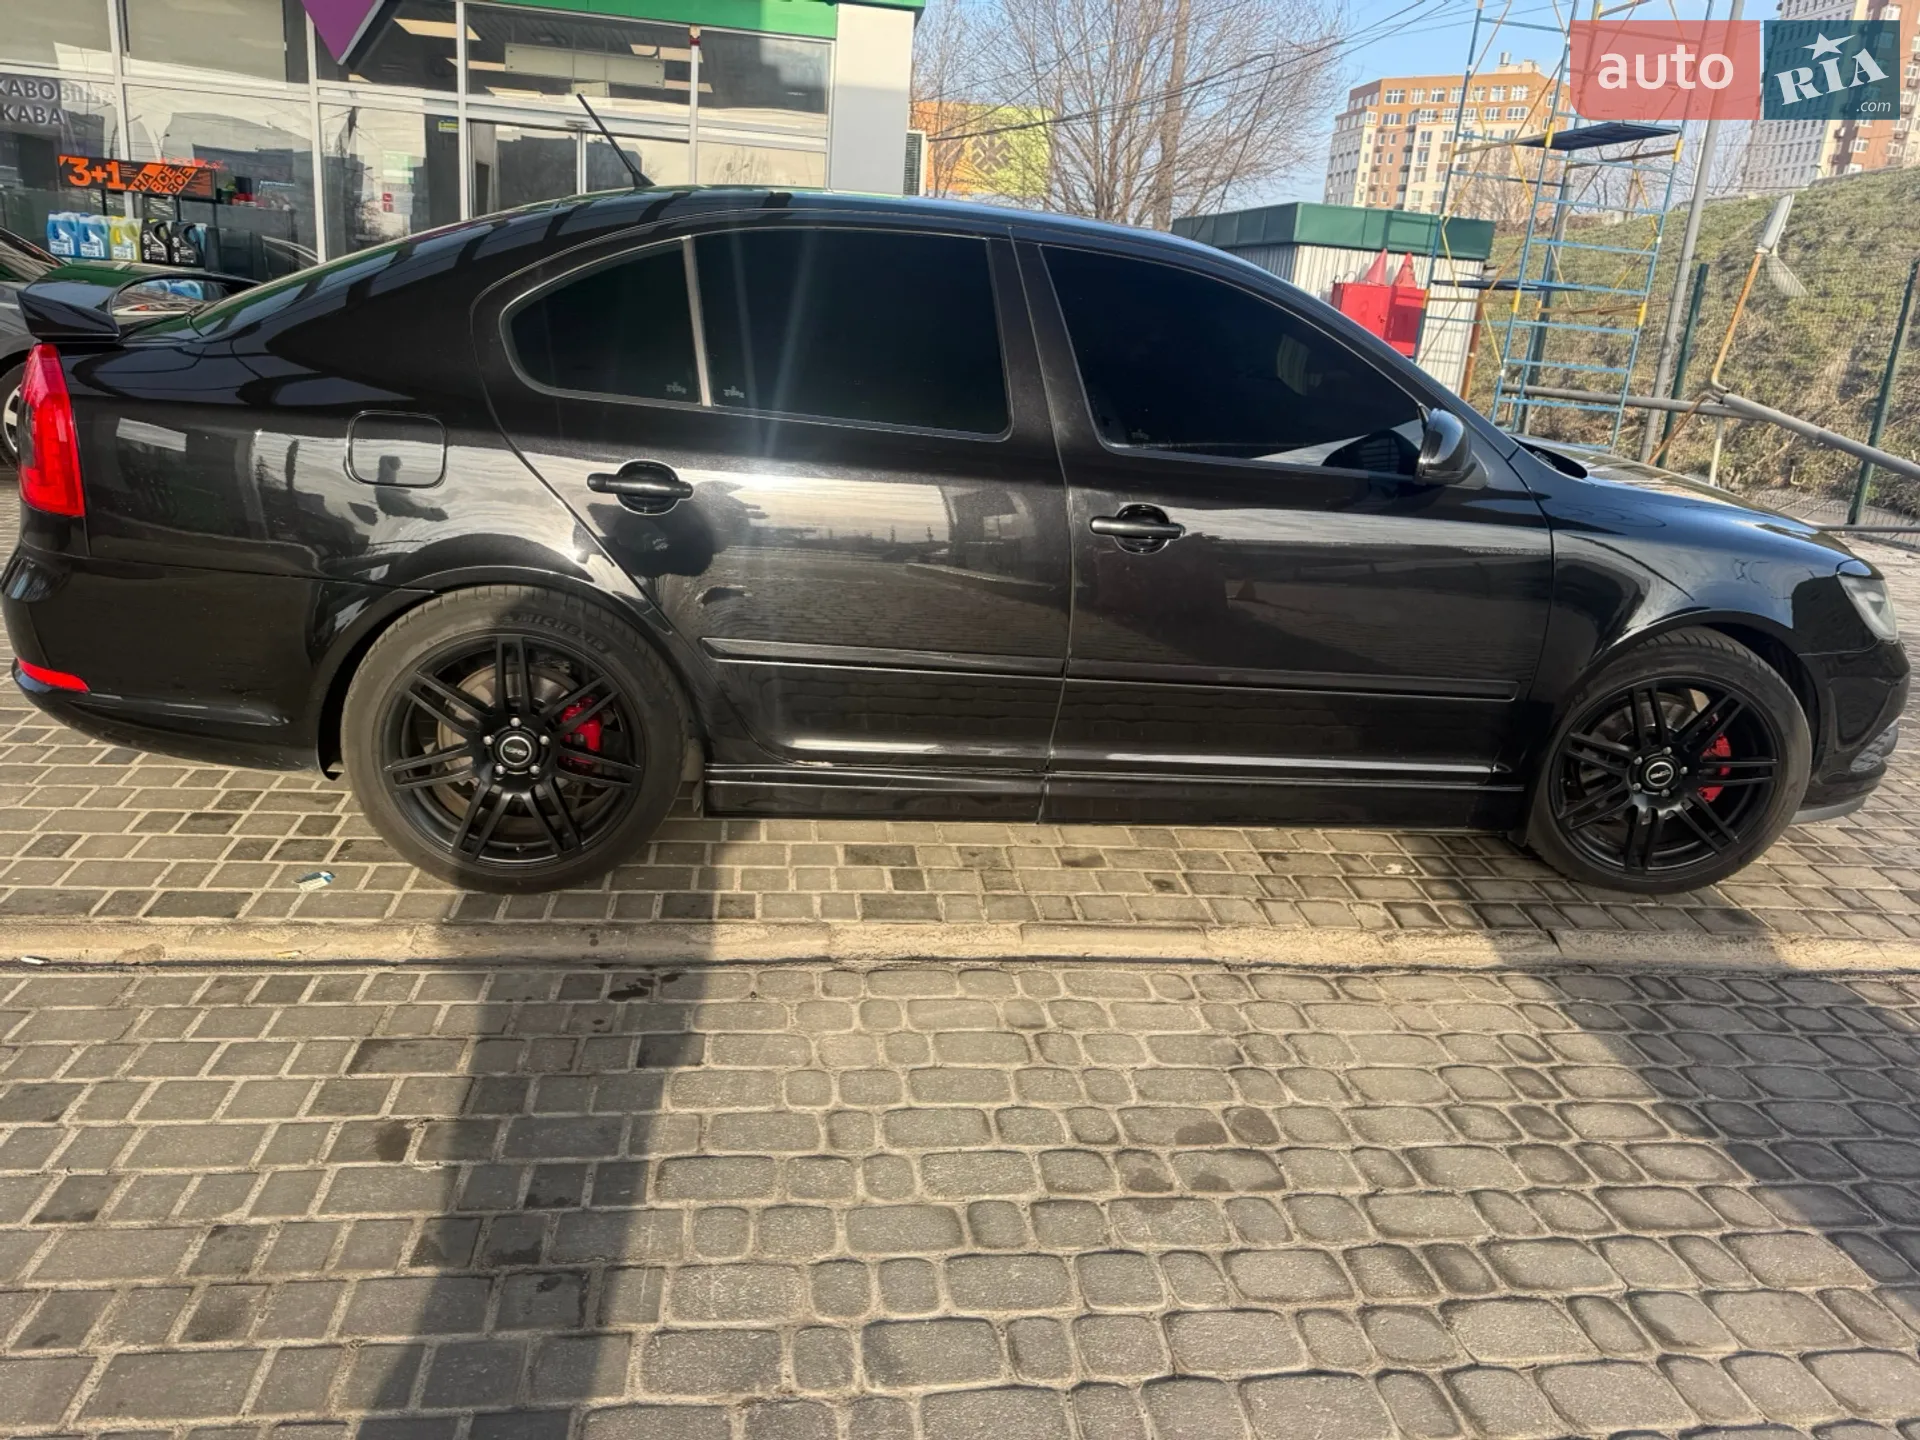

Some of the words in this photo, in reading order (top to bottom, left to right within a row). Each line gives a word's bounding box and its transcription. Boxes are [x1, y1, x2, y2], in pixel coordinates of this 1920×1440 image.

[0, 103, 64, 125] КАВА
[68, 157, 127, 190] 3+1
[133, 172, 154, 192] НА
[150, 165, 177, 193] ВСЕ
[166, 167, 193, 195] ВСЕ
